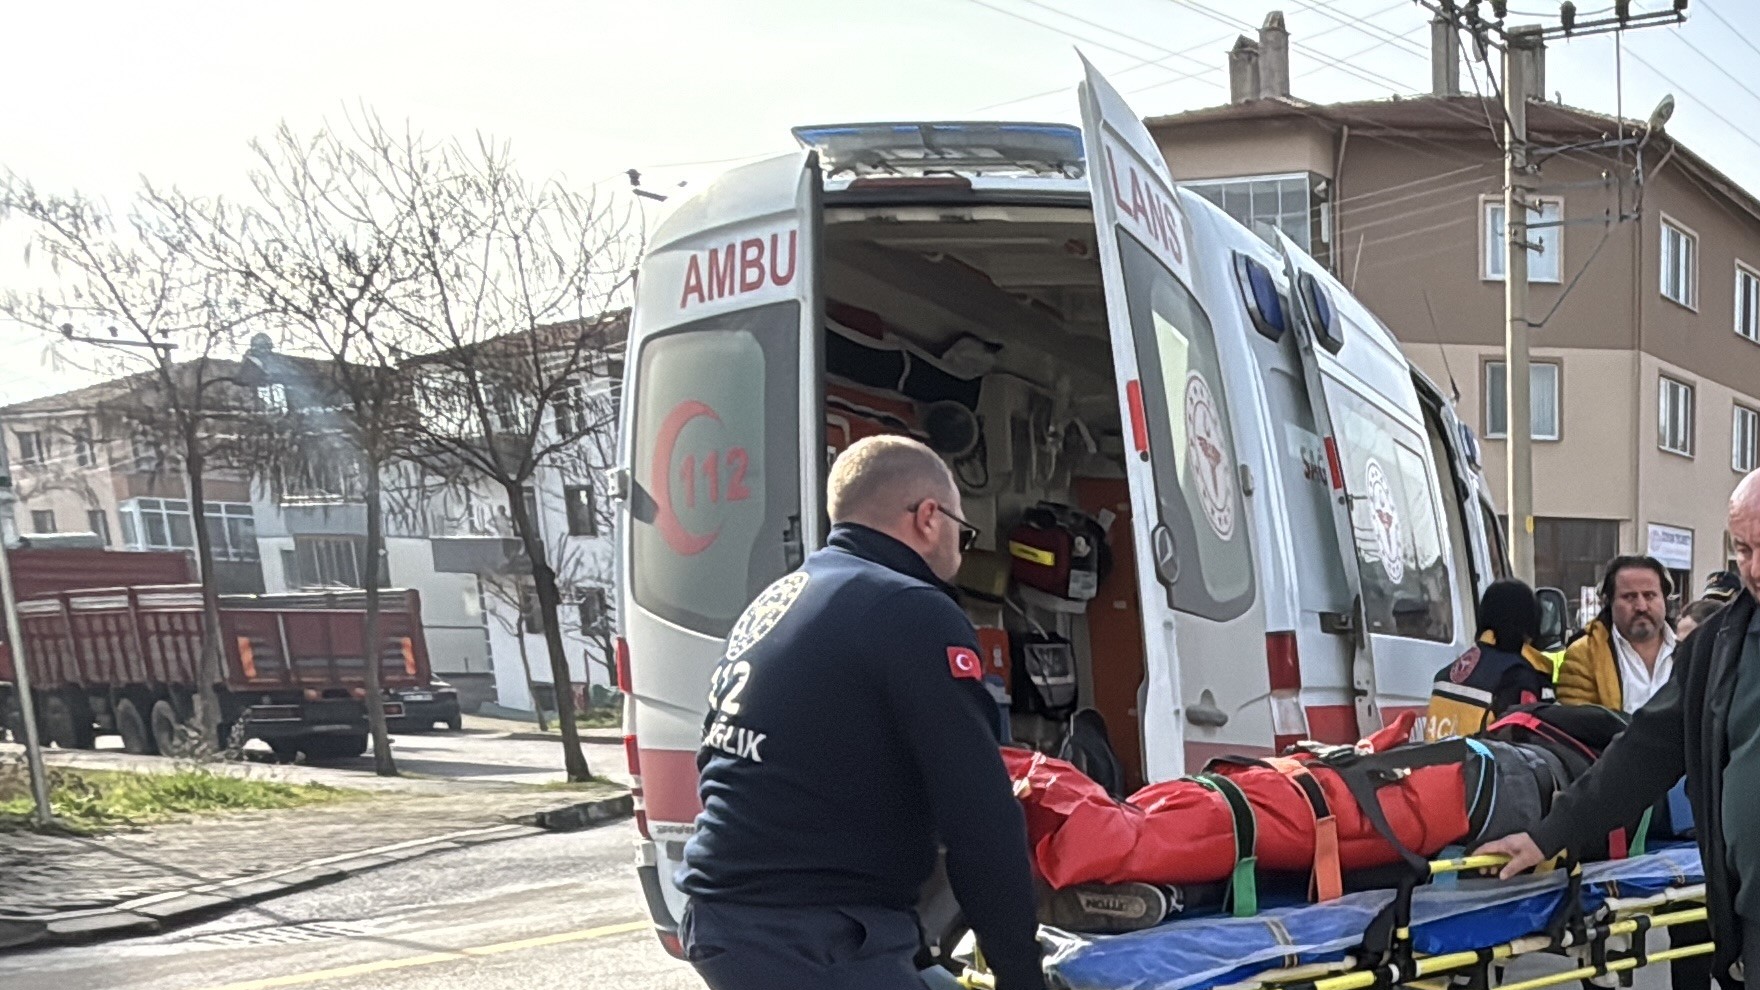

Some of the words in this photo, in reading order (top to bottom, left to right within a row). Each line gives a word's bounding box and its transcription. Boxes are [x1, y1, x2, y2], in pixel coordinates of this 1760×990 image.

[1106, 144, 1183, 266] LANS
[680, 229, 798, 310] AMBU
[679, 446, 751, 509] 112
